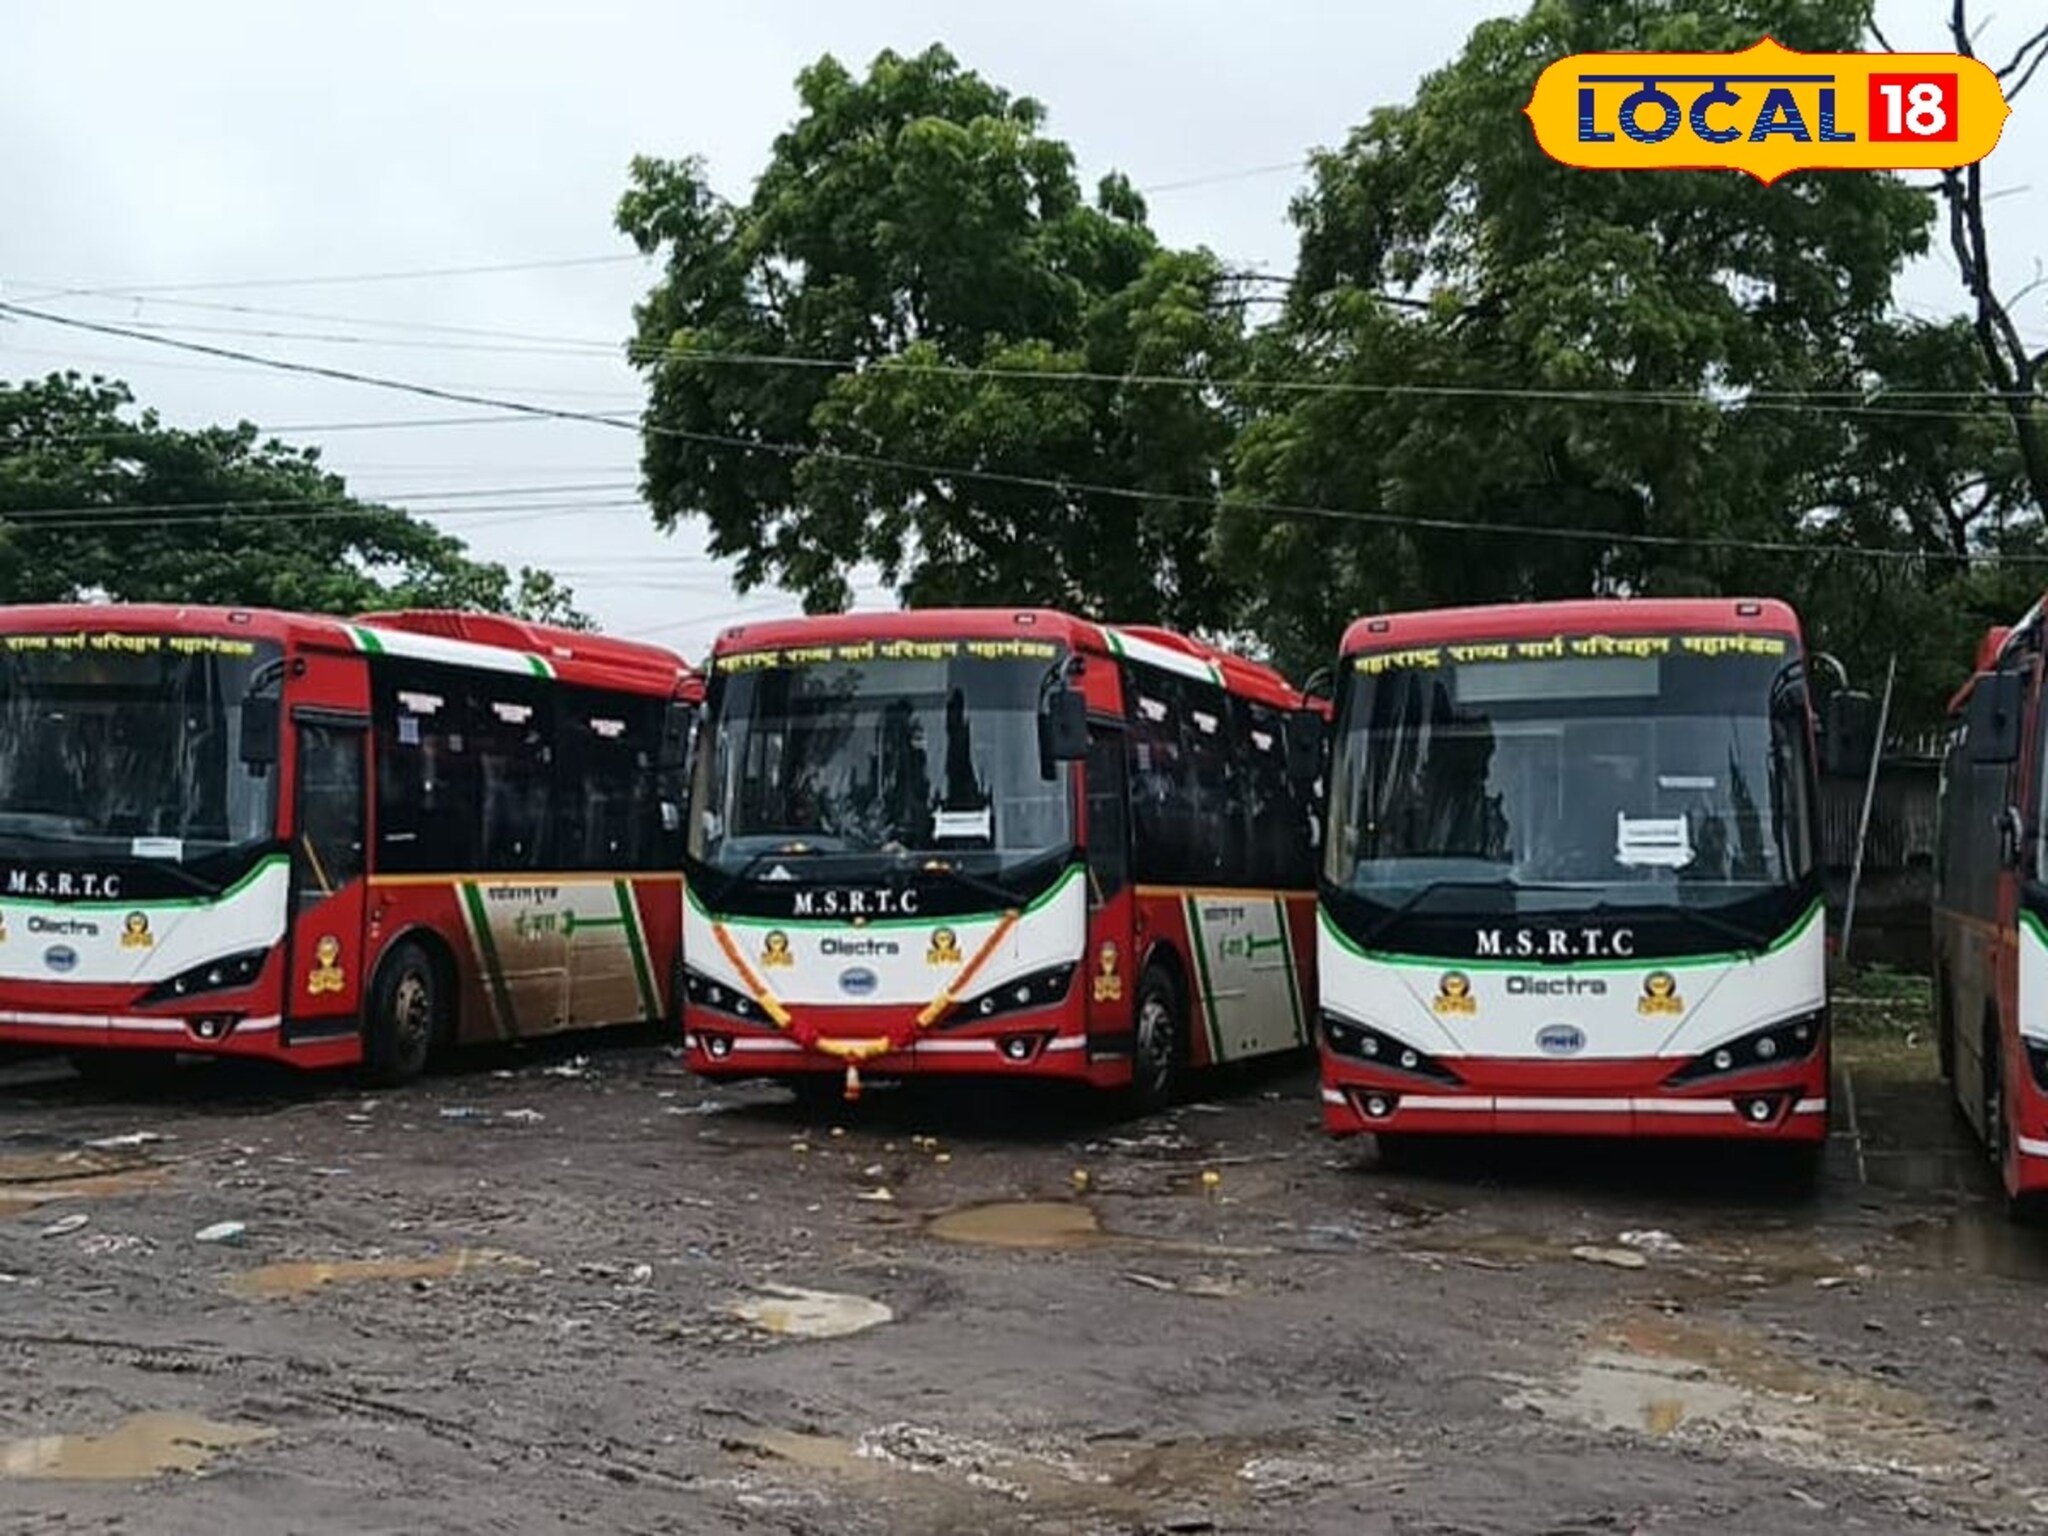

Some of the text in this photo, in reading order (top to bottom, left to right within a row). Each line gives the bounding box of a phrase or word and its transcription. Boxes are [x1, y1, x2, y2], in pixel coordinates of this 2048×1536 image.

[1447, 643, 1510, 662] राज्य
[1516, 635, 1563, 658] मार्ग
[1570, 633, 1671, 658] परिवहन
[7, 869, 121, 898] M.S.R.T.C
[793, 889, 919, 915] M.S.R.T.C
[1476, 928, 1635, 957] M.S.R.T.C
[1505, 974, 1608, 996] Olectra
